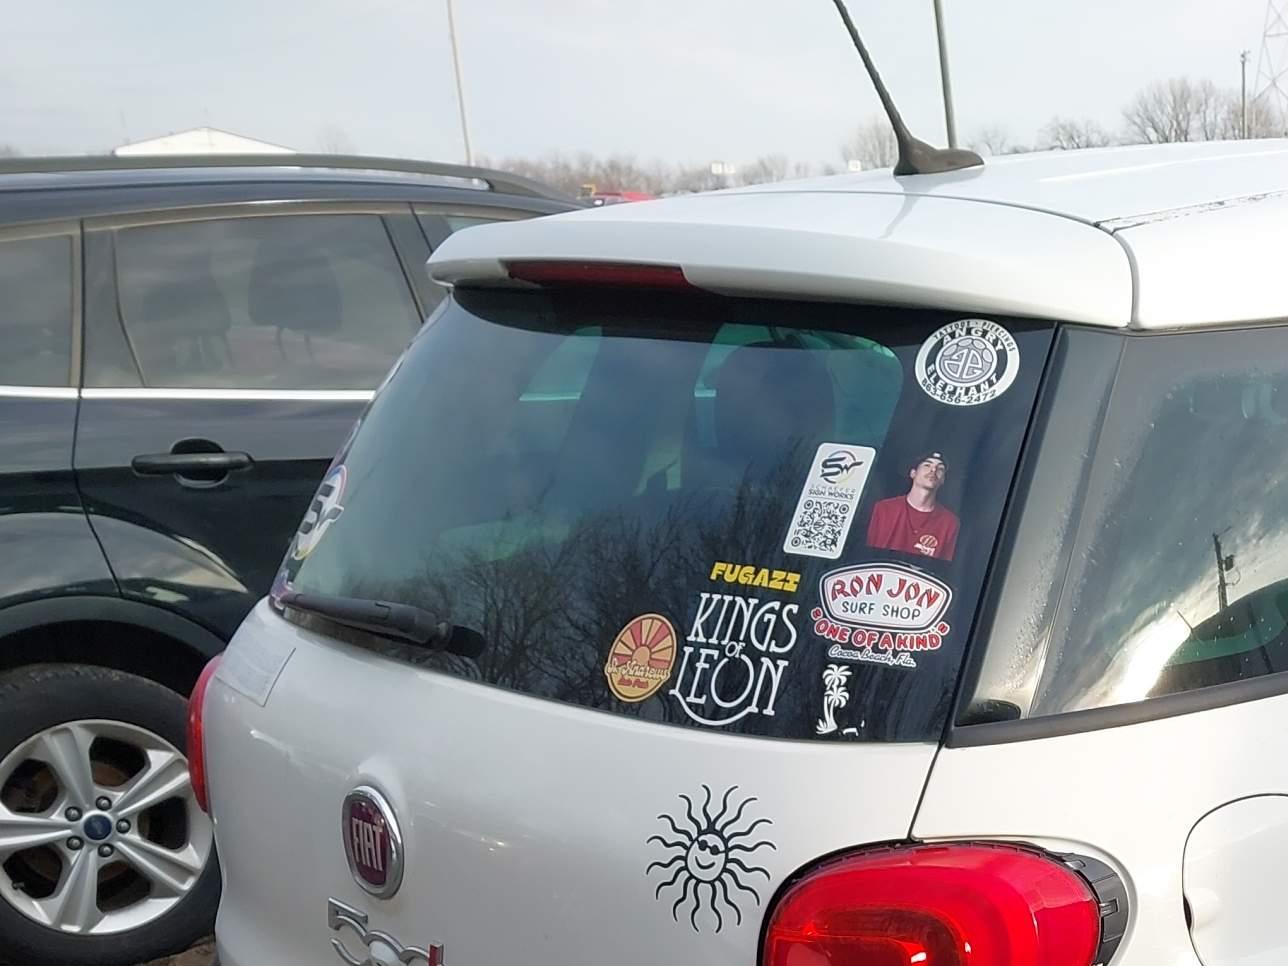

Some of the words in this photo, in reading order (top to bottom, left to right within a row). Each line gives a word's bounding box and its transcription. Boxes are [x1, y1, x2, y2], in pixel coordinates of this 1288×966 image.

[934, 320, 970, 340] TATTOOS
[981, 321, 1016, 352] PIERCINGS
[942, 327, 1005, 351] ANGRY
[926, 363, 1000, 398] ELEPHANT
[827, 490, 855, 500] WORKS
[710, 562, 800, 592] FUGAZI
[831, 573, 884, 602] RON
[886, 577, 940, 609] JON
[686, 592, 799, 653] KINGS
[842, 600, 876, 615] SURF
[882, 604, 921, 620] SHOP
[852, 629, 878, 648] OF
[879, 632, 894, 650] A
[669, 646, 789, 726] LEON
[351, 816, 385, 872] FIAT
